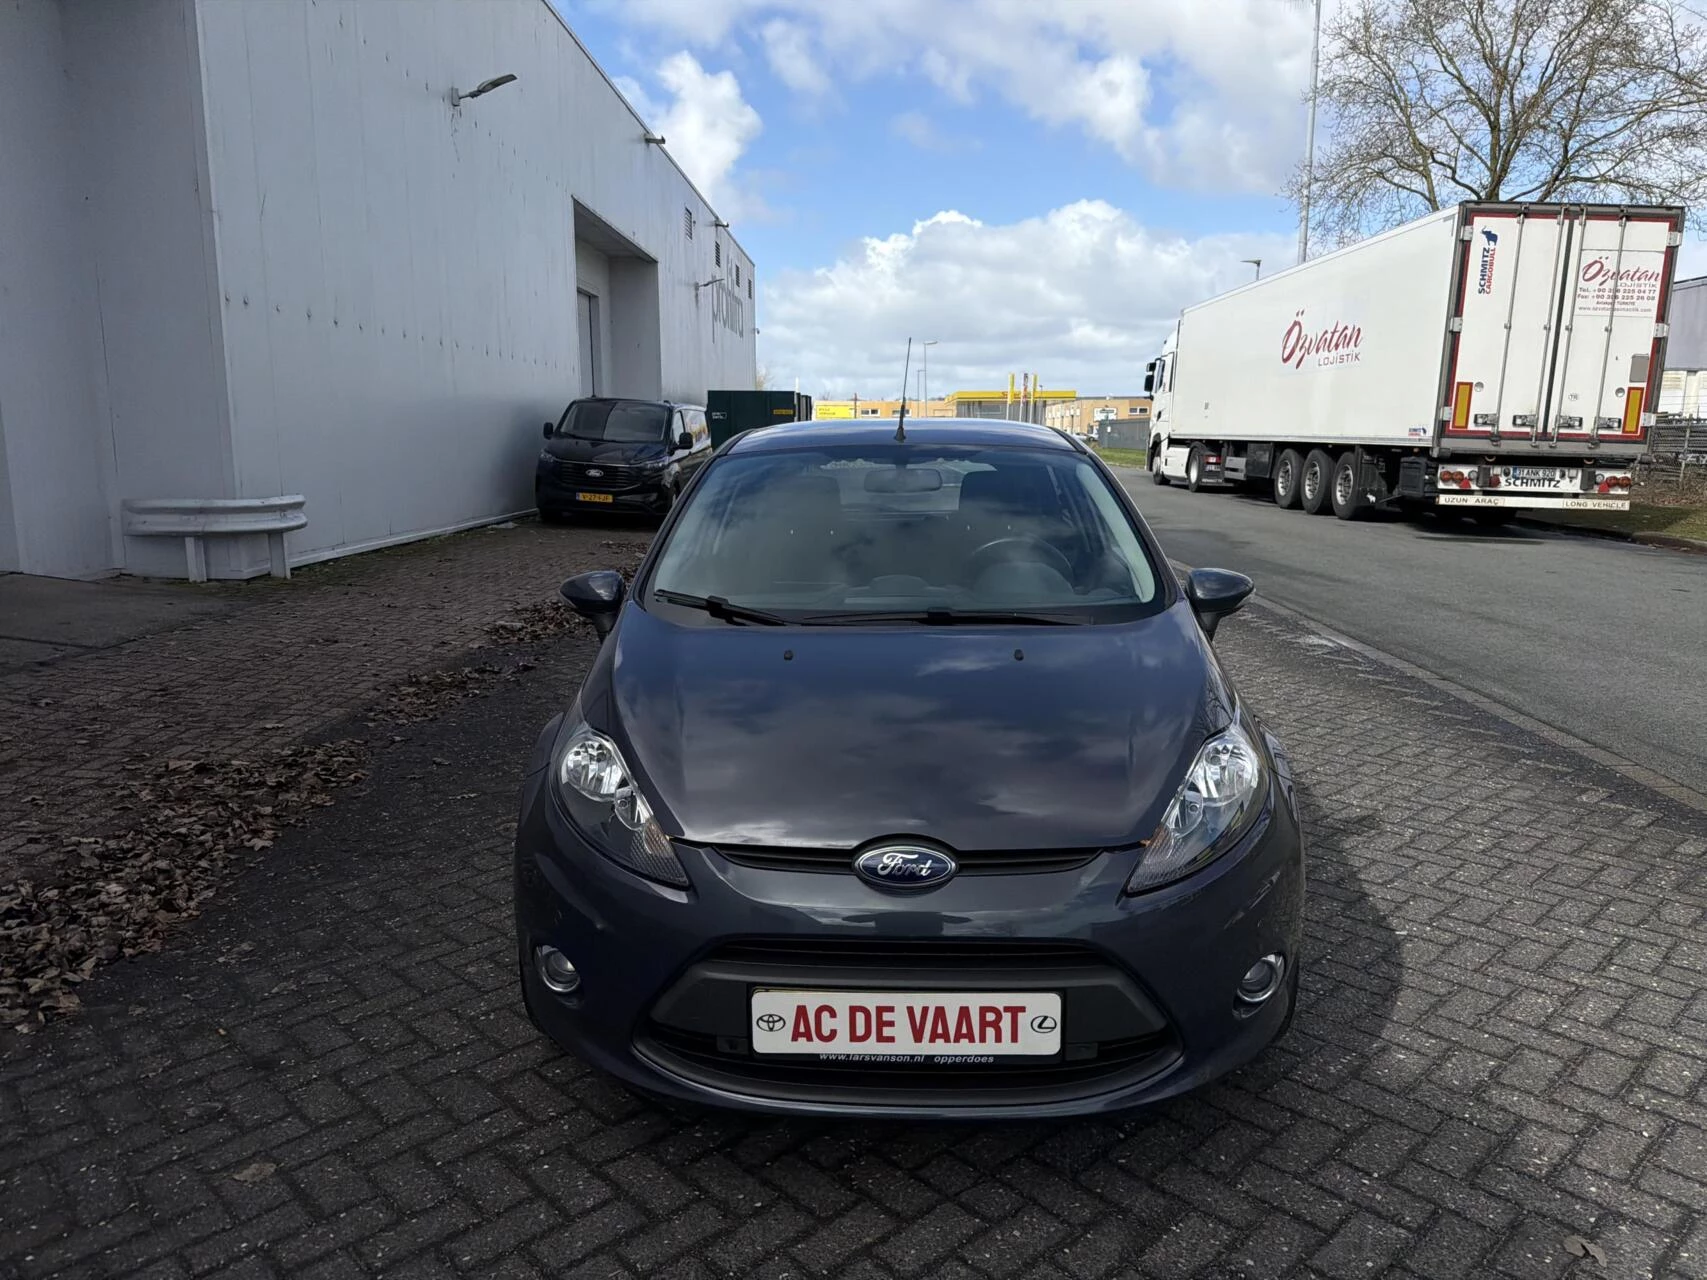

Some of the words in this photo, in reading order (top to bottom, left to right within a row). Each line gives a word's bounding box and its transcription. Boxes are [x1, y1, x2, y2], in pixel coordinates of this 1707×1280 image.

[1478, 247, 1490, 294] SCHMITZ
[1485, 247, 1496, 294] CARGOBULL
[1582, 256, 1660, 286] Özvatan
[1281, 309, 1363, 370] Özvatan
[1318, 350, 1361, 367] LOJİSTİK
[1504, 477, 1560, 489] SCHMITZ
[1475, 498, 1499, 506] ARAÇ
[877, 852, 932, 877] Ford
[791, 1004, 838, 1043] AC
[848, 1005, 896, 1043] DE
[906, 1005, 1027, 1044] VAART
[819, 1052, 925, 1063] www.larsvanson.nl
[934, 1055, 994, 1064] opperdoes
